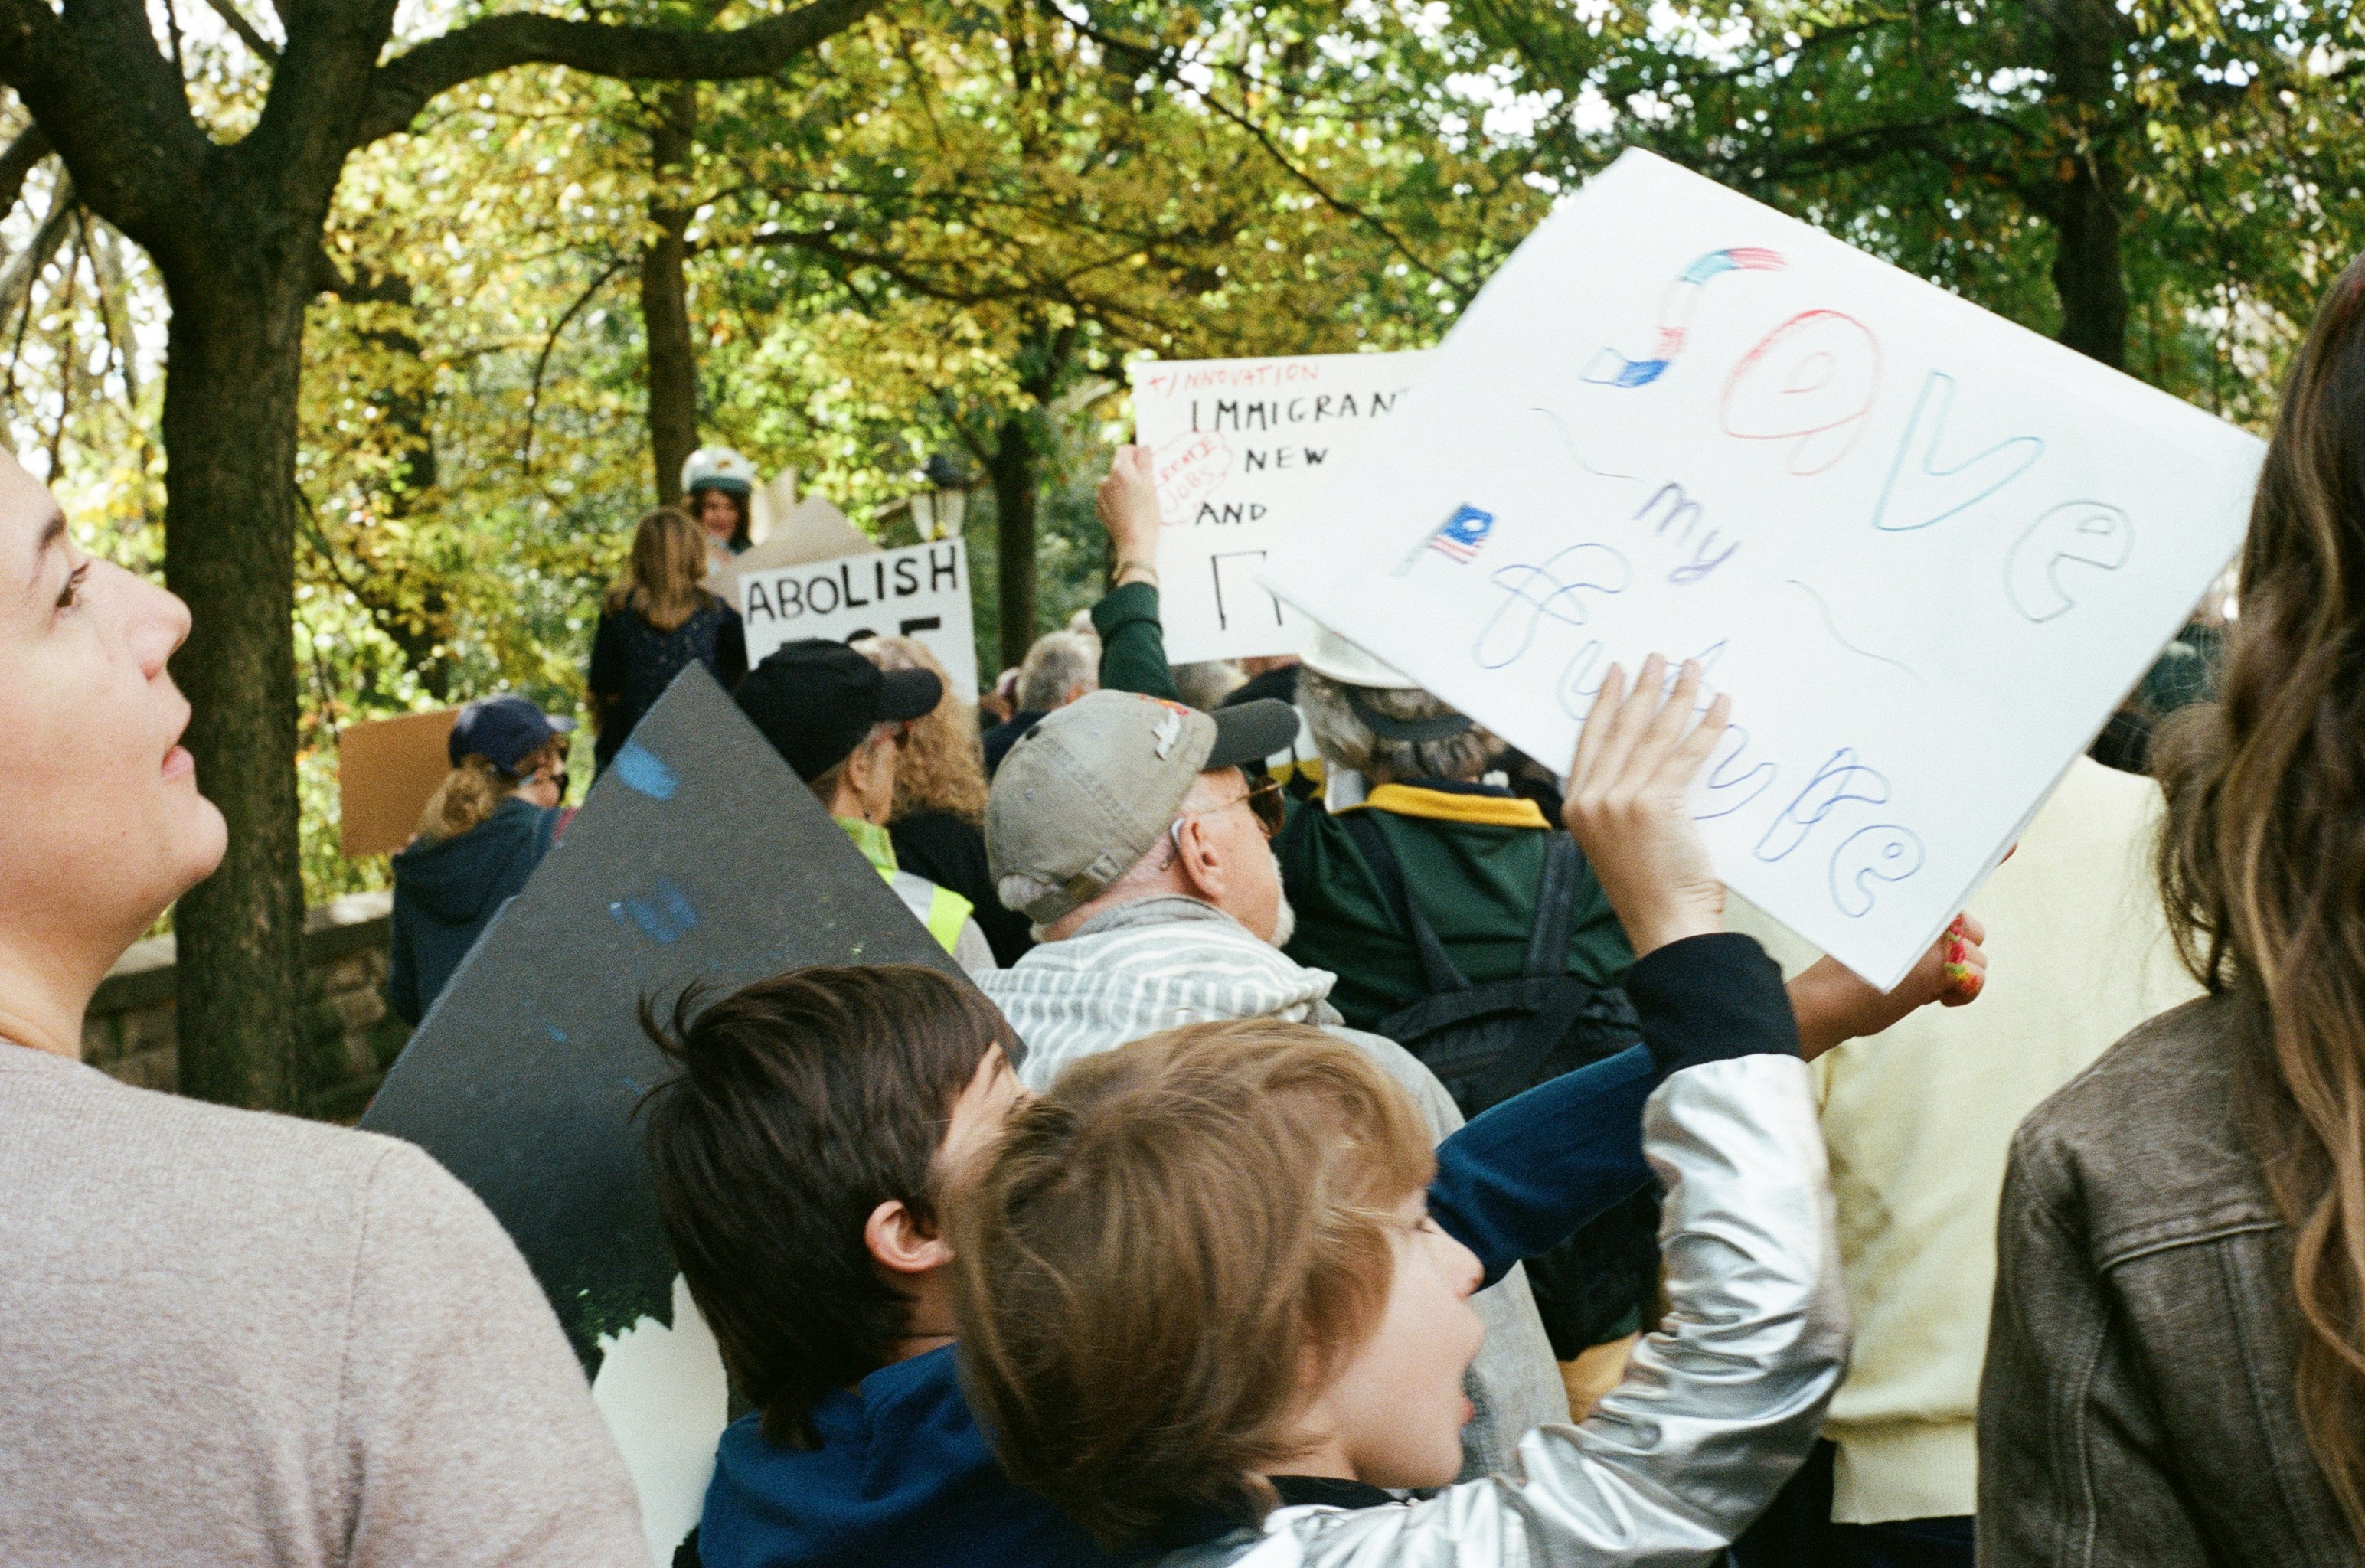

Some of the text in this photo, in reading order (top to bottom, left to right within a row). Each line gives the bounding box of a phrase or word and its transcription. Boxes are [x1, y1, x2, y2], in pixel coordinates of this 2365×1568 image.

[1191, 387, 1410, 433] IMMIGRAN
[1245, 446, 1328, 472] NEW
[1194, 501, 1267, 525] AND
[747, 544, 958, 626] ABOLISH
